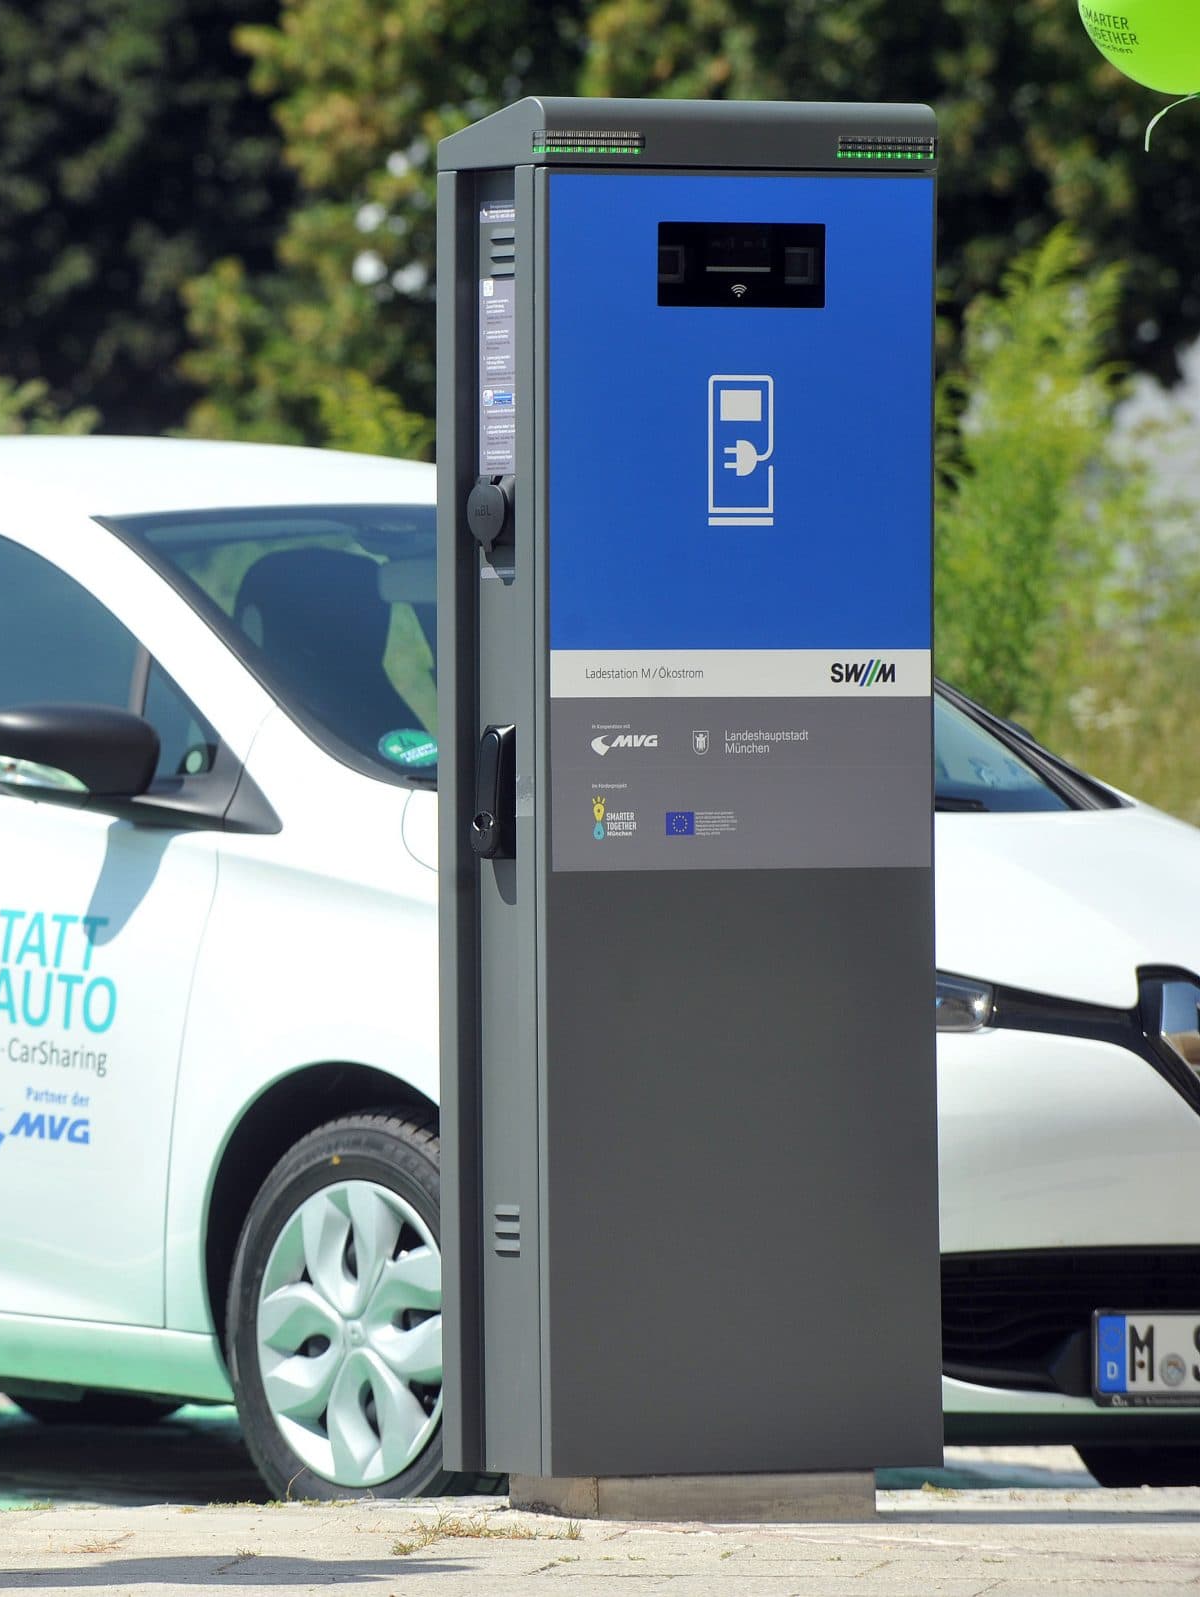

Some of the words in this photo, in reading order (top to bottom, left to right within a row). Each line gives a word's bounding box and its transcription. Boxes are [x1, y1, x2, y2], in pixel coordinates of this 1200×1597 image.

[585, 667, 638, 679] Ladestation
[610, 734, 659, 748] MVG
[724, 730, 809, 743] Landeshauptstadt
[724, 742, 770, 754] München
[606, 812, 635, 821] SMARTER
[606, 821, 637, 831] TOGETHER
[26, 1086, 68, 1104] Partner
[71, 1089, 90, 1107] der
[9, 1112, 90, 1145] MVG
[1129, 1324, 1154, 1382] M
[1106, 1361, 1118, 1380] D
